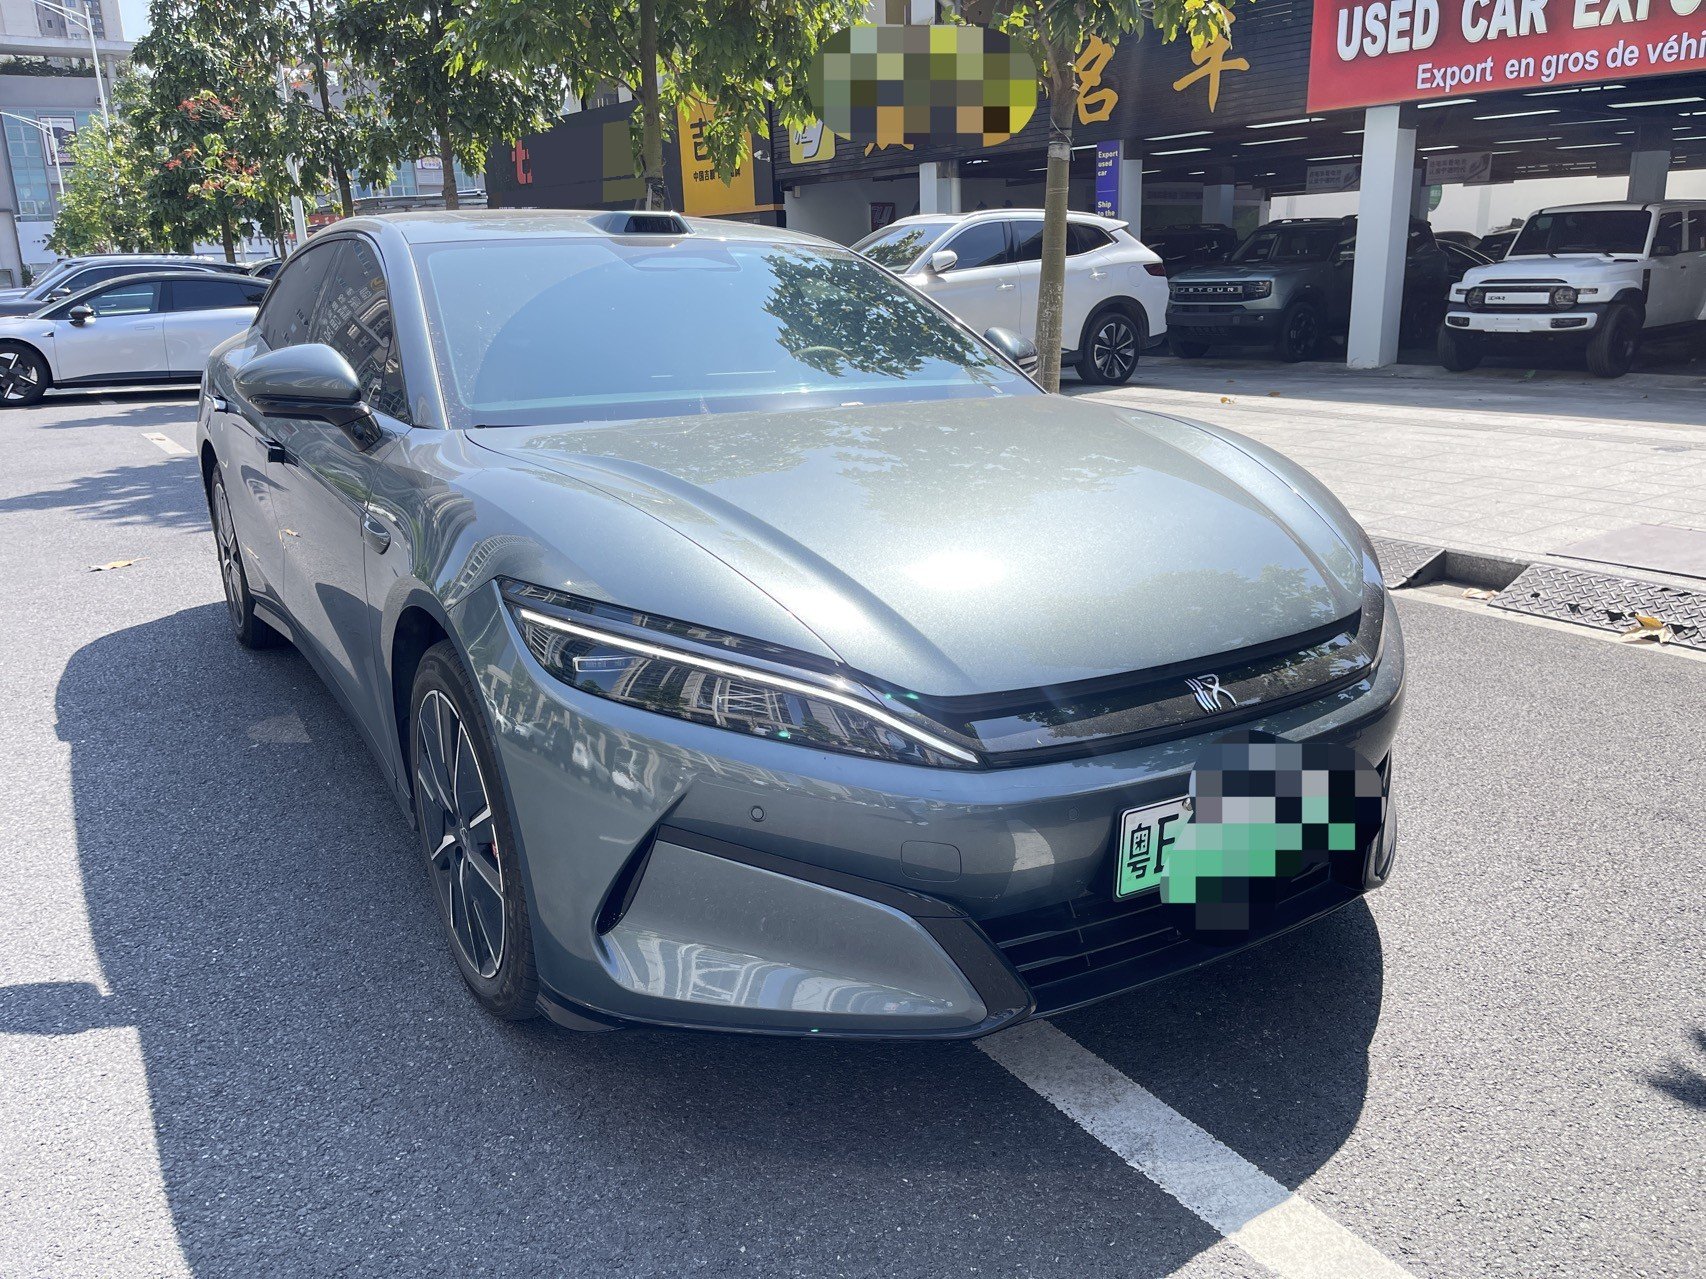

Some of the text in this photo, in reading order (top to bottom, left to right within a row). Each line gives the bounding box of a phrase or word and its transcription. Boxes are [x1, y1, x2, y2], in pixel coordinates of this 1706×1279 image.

[1337, 0, 1440, 61] USED
[1461, 0, 1548, 43] CAR
[1416, 30, 1706, 92] Export en gros de véhi
[1098, 150, 1118, 159] Export
[1097, 201, 1112, 209] Ship
